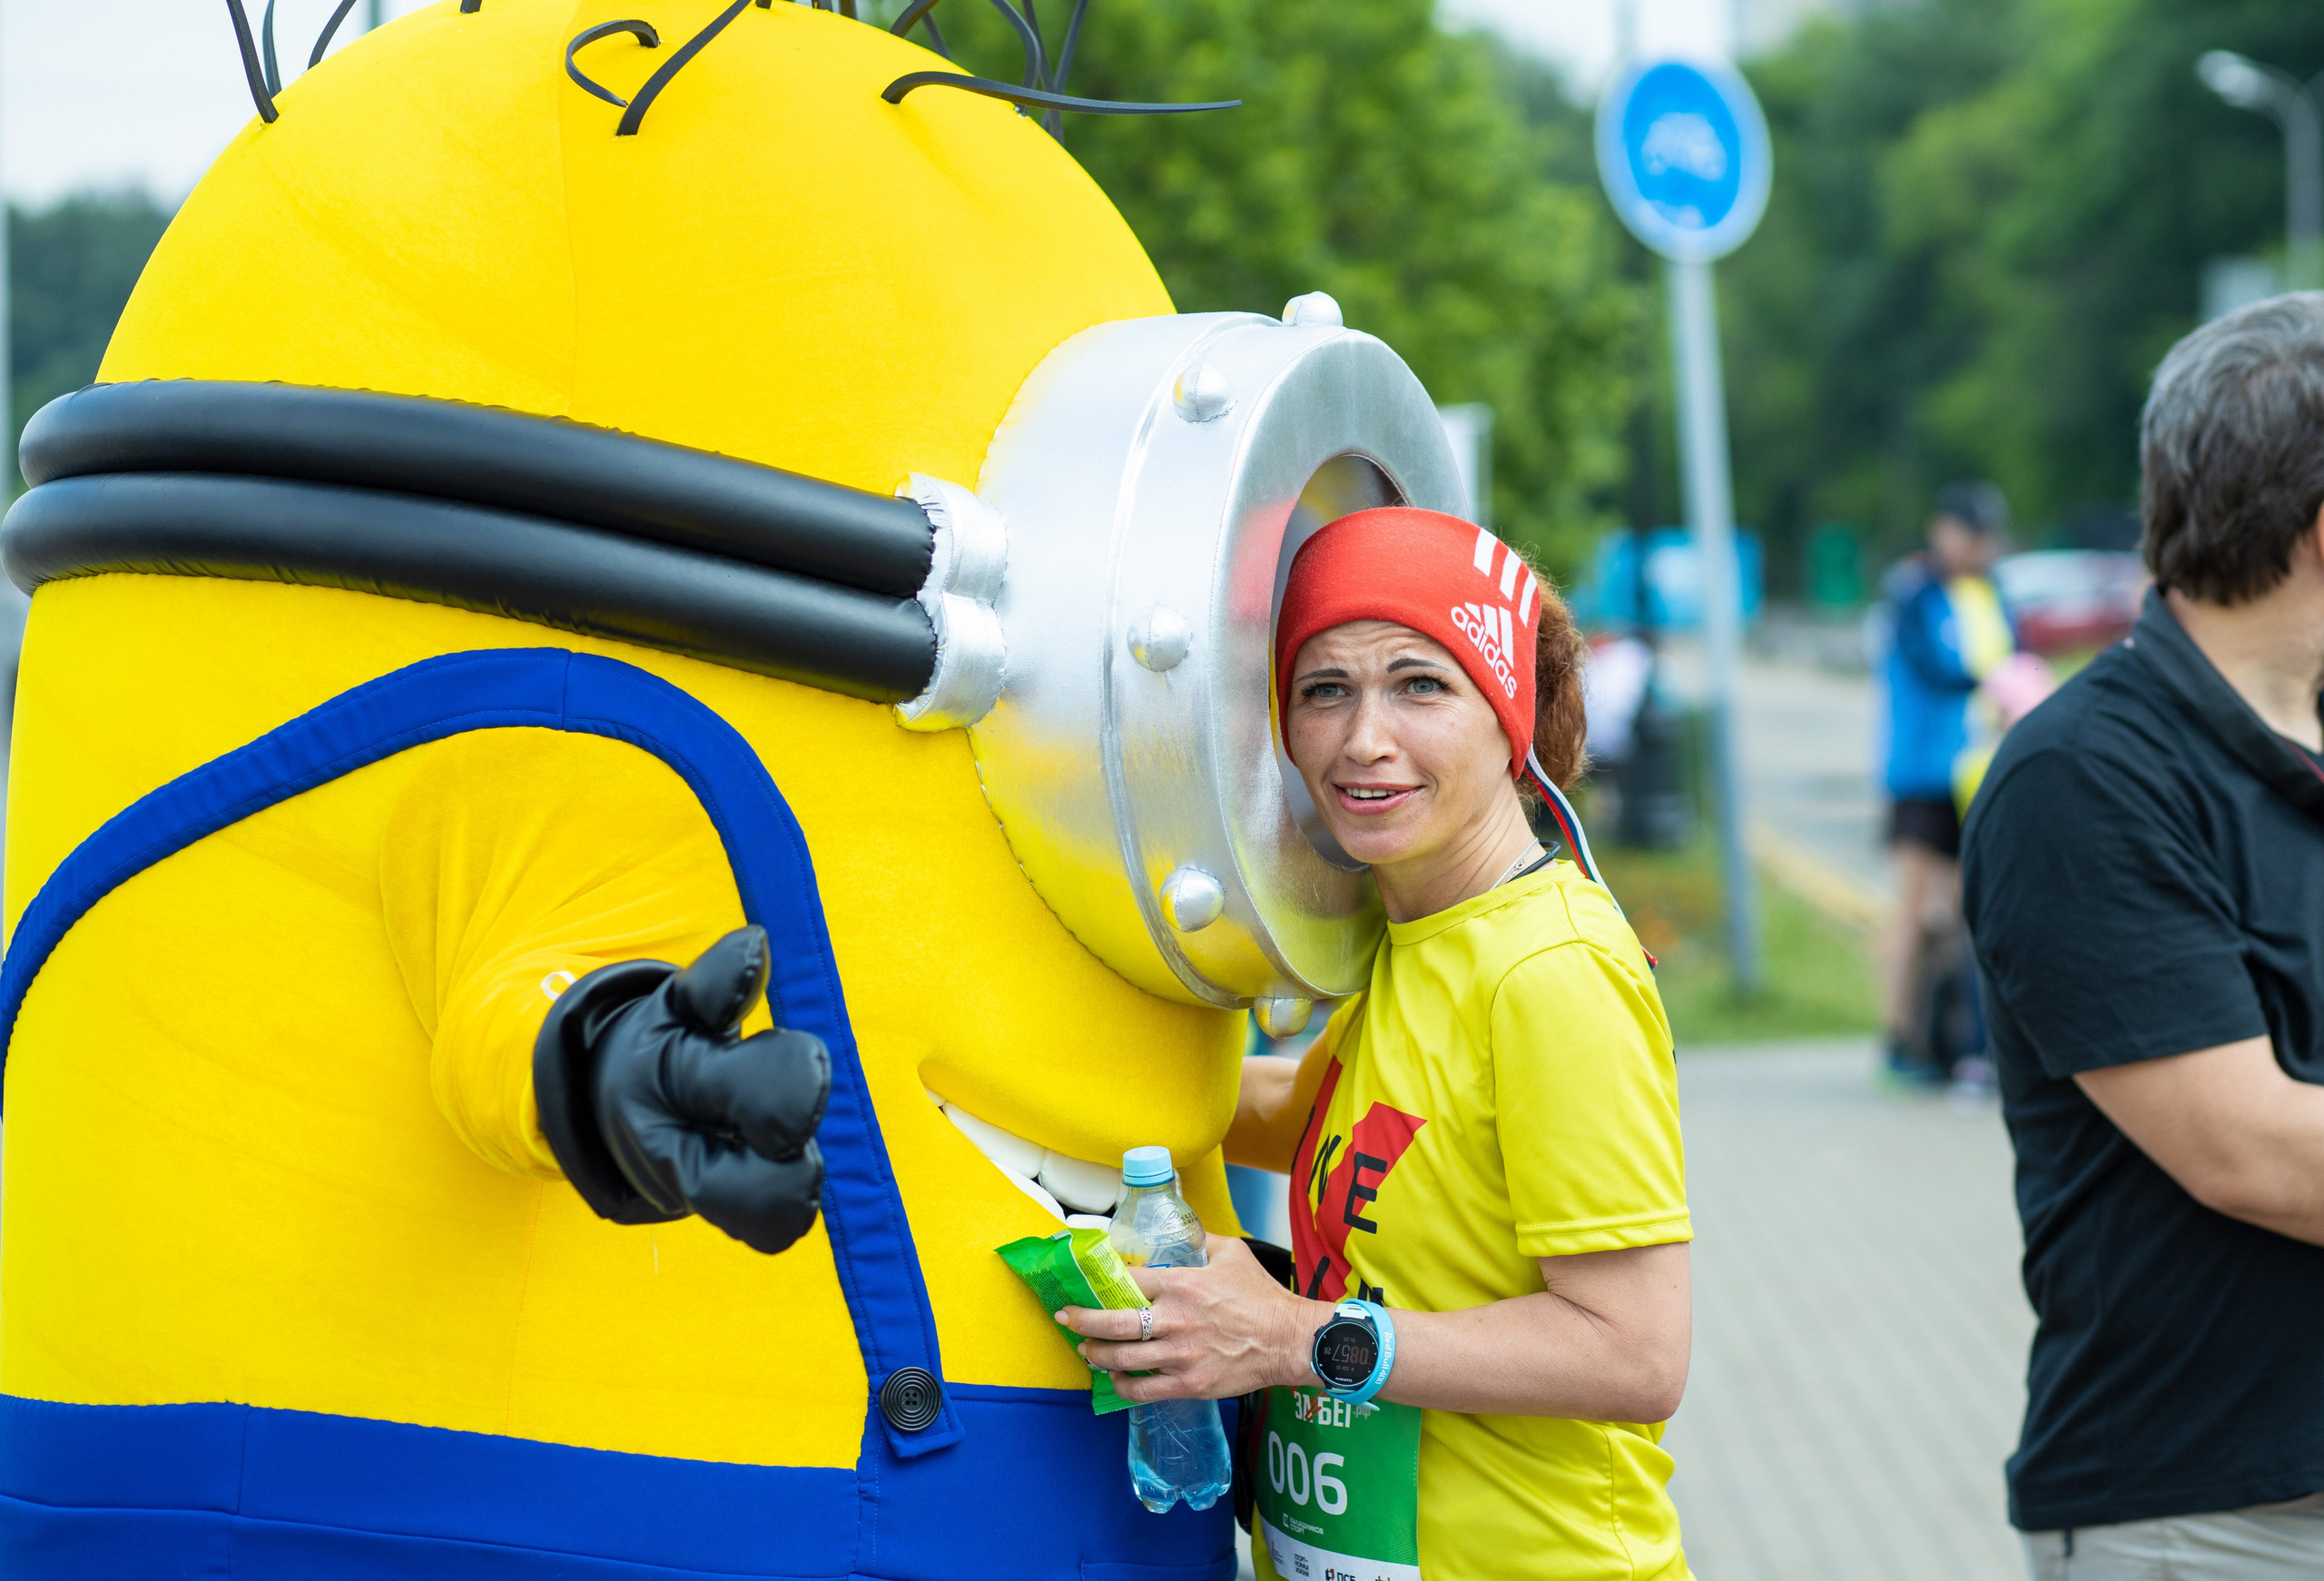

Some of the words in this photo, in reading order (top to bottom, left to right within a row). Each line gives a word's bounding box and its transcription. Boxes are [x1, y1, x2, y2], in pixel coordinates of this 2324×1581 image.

[1451, 606, 1517, 699] adidas
[1384, 1331, 1393, 1351] Red
[1382, 1351, 1392, 1369] Bull
[1374, 1369, 1387, 1385] 400
[1268, 1430, 1348, 1516] 006
[1289, 1517, 1324, 1535] КАЛАШНИКОВ
[1289, 1524, 1305, 1536] СПОРТ
